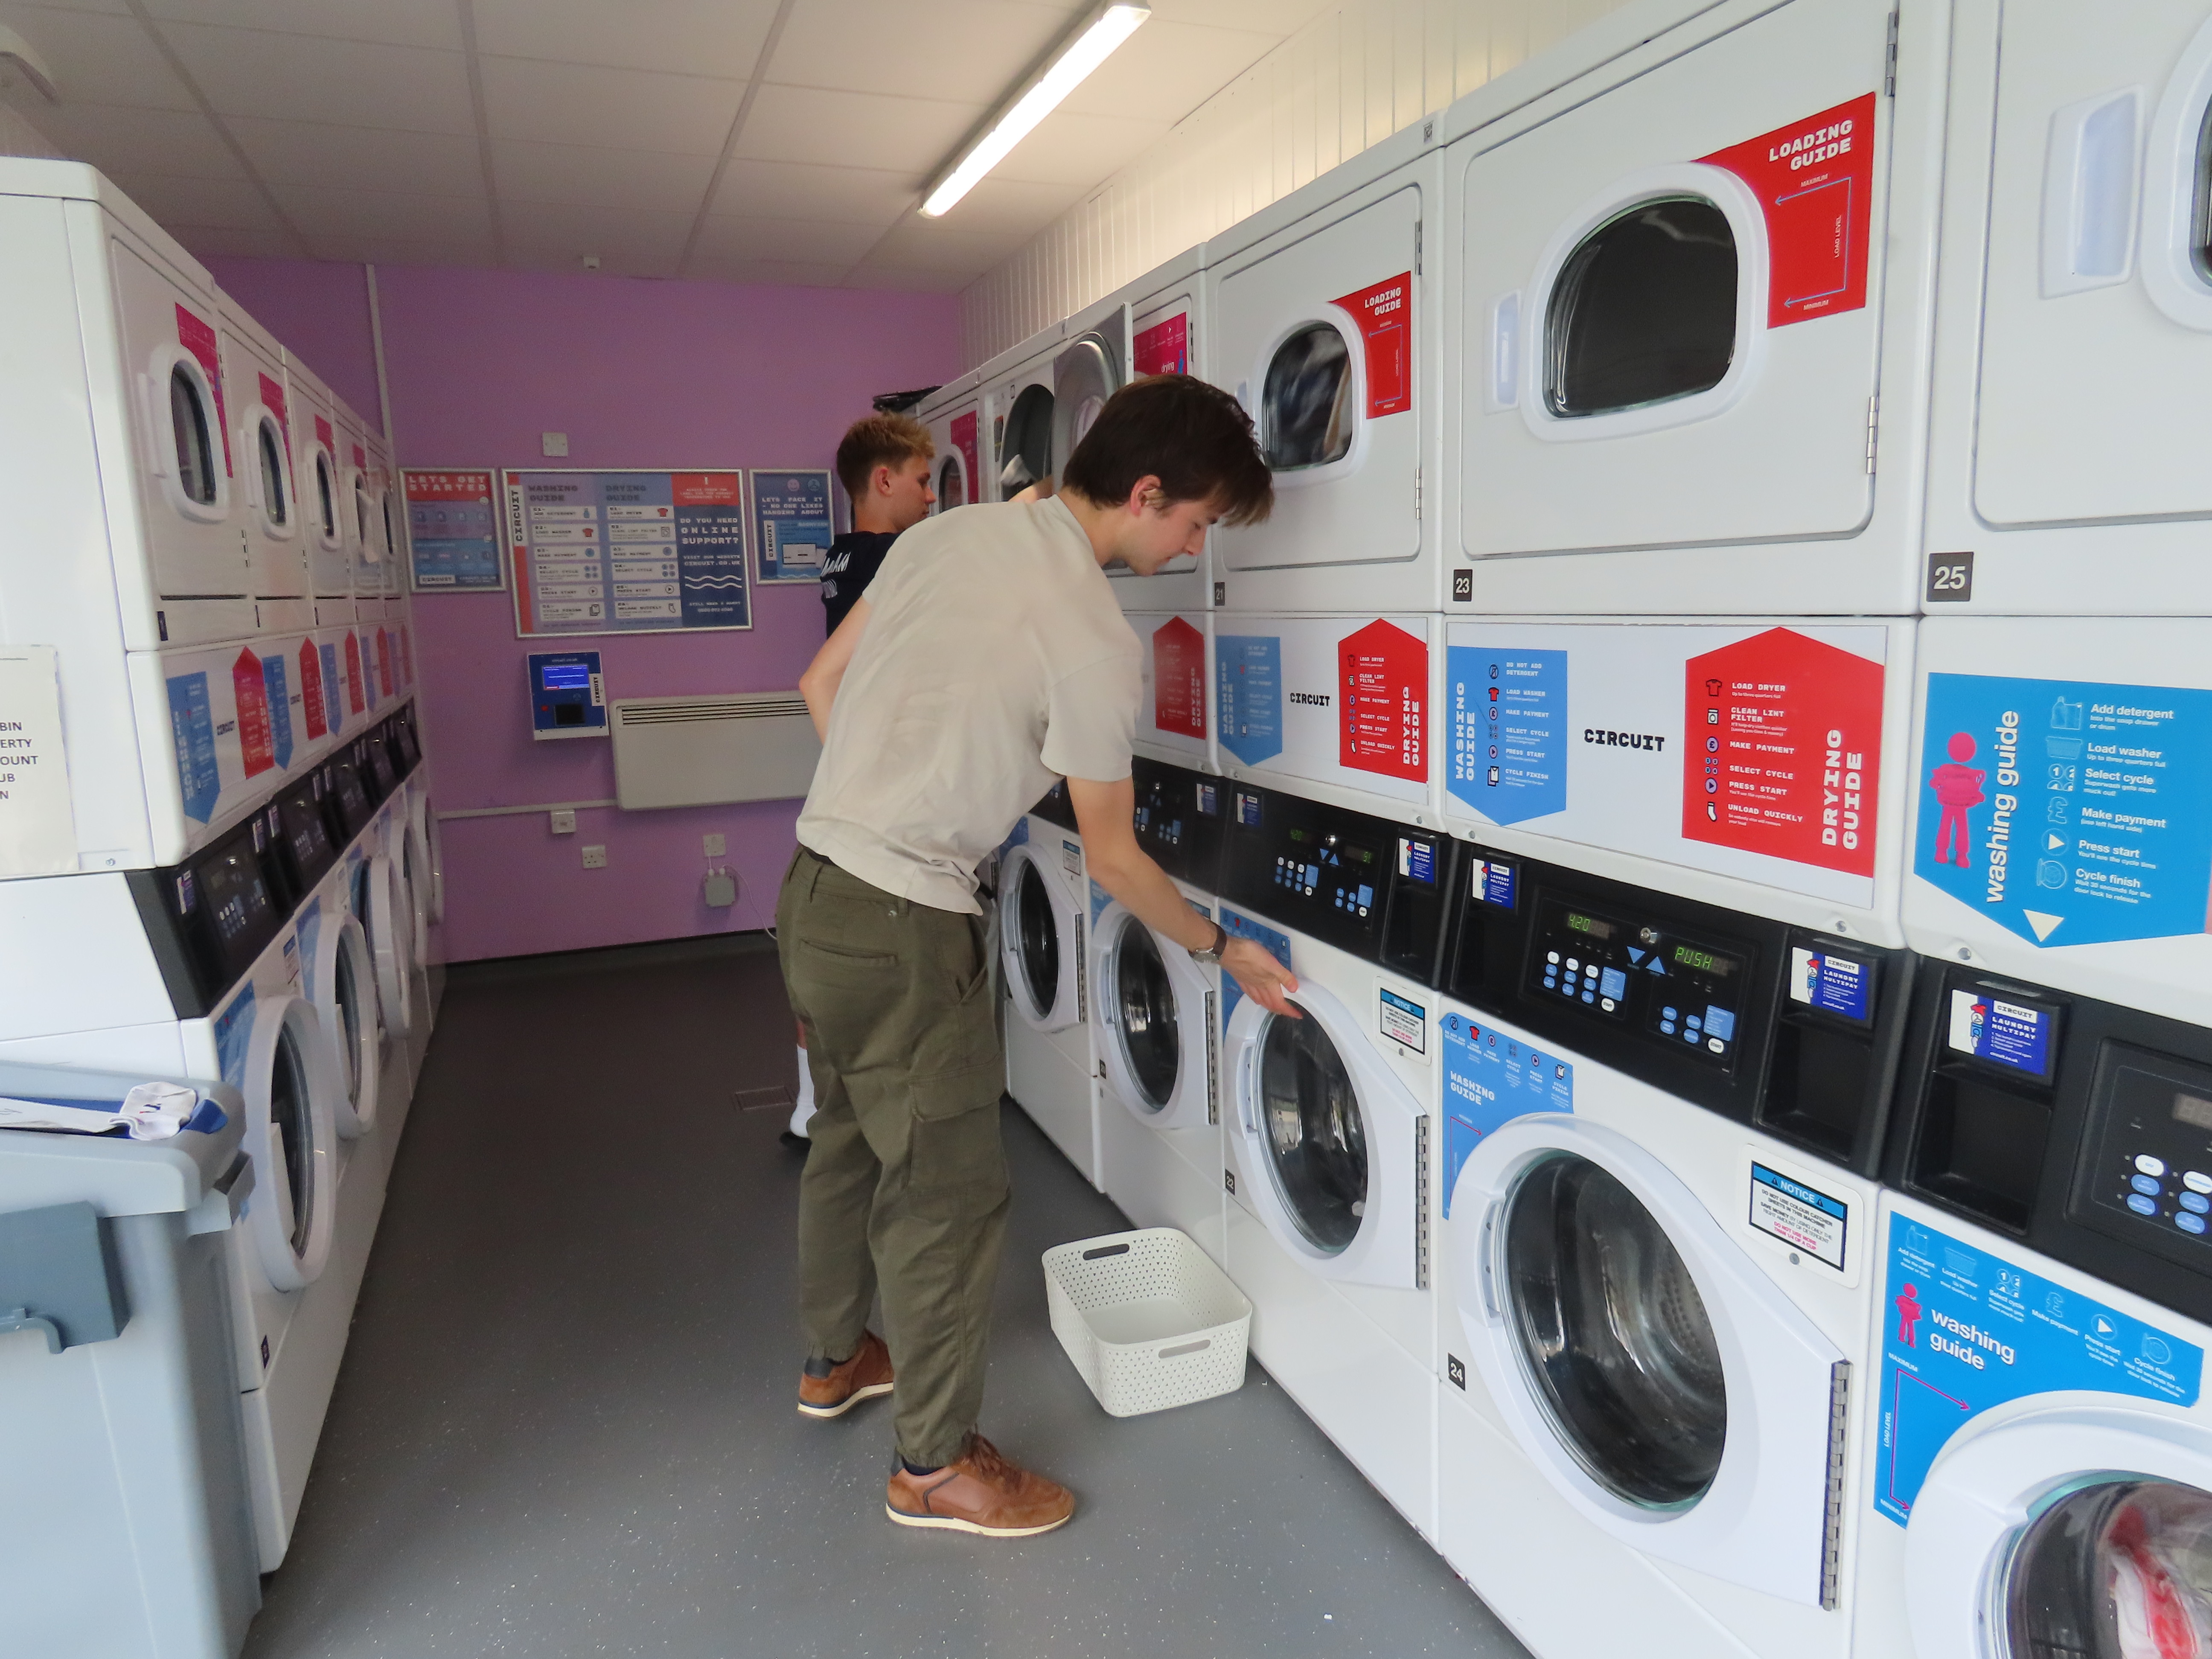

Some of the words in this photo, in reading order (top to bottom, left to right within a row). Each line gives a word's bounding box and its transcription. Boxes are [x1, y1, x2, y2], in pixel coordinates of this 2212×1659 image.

[1769, 119, 1853, 162] LOADING
[1790, 137, 1852, 170] GUIDE
[1801, 173, 1828, 188] MAXIMUM
[1365, 287, 1402, 309] LOADING
[1374, 298, 1401, 316] GUIDE
[512, 490, 523, 542] CIRCUIT
[1455, 577, 1471, 595] 23
[1934, 565, 1966, 591] 25
[1216, 589, 1223, 600] 21
[1758, 684, 1786, 692] DRYER
[1290, 692, 1330, 707] CIRCUIT
[1731, 707, 1758, 715] CLEAN
[1763, 709, 1784, 718] LINT
[1731, 714, 1763, 723] FILTER
[2091, 704, 2115, 714] Add
[2116, 705, 2174, 720] detergent
[1412, 701, 1420, 766] GUIDE
[1456, 682, 1465, 780] WASHING
[1584, 728, 1665, 752] CIRCUIT
[1466, 712, 1475, 781] GUIDE
[1730, 741, 1751, 749] MAKE
[1756, 744, 1795, 754] PAYMENT
[1994, 710, 2020, 787] guide
[2088, 742, 2117, 754] Load
[2119, 748, 2163, 759] washer
[1526, 771, 1548, 780] FINISH
[1729, 765, 1761, 775] SELECT
[1766, 770, 1794, 780] CYCLE
[2085, 768, 2121, 781] Select
[2123, 774, 2155, 785] cycle
[1729, 781, 1755, 791] PRESS
[1760, 786, 1787, 796] START
[1822, 729, 1842, 846] DRYING
[1842, 752, 1863, 850] GUIDE
[1728, 803, 1759, 815] UNLOAD
[1764, 810, 1803, 823] QUICKLY
[2081, 807, 2113, 820] Make
[2114, 813, 2167, 829] payment
[1985, 793, 2017, 903] washing
[2078, 839, 2111, 853] Press
[2112, 847, 2140, 859] start
[1490, 874, 1510, 882] LAUNDRY
[1490, 879, 1510, 887] MULTIPAY
[2075, 868, 2107, 882] Cycle
[2109, 874, 2141, 889] finish
[1569, 913, 1591, 932] 4.20
[1675, 946, 1713, 969] PUSH
[1828, 960, 1856, 970] CIRCUIT
[1823, 976, 1858, 990] MULTIPAY
[1824, 969, 1859, 983] LAUNDRY
[1393, 998, 1411, 1011] NOTICE
[1997, 1005, 2033, 1019] CIRCUIT
[1991, 1024, 2036, 1040] MULTIPAY
[1992, 1016, 2037, 1033] LAUNDRY
[1450, 1070, 1495, 1101] WASHING
[1450, 1082, 1482, 1106] GUIDE
[1226, 1176, 1234, 1190] 22
[1780, 1179, 1816, 1204] NOTICE
[1806, 1242, 1817, 1251] CUP
[1931, 1308, 2016, 1366] washing
[1930, 1333, 1986, 1371] guide
[1888, 1352, 1918, 1373] MAXIMUM
[2133, 1357, 2155, 1371] Cycle
[1450, 1362, 1464, 1383] 24
